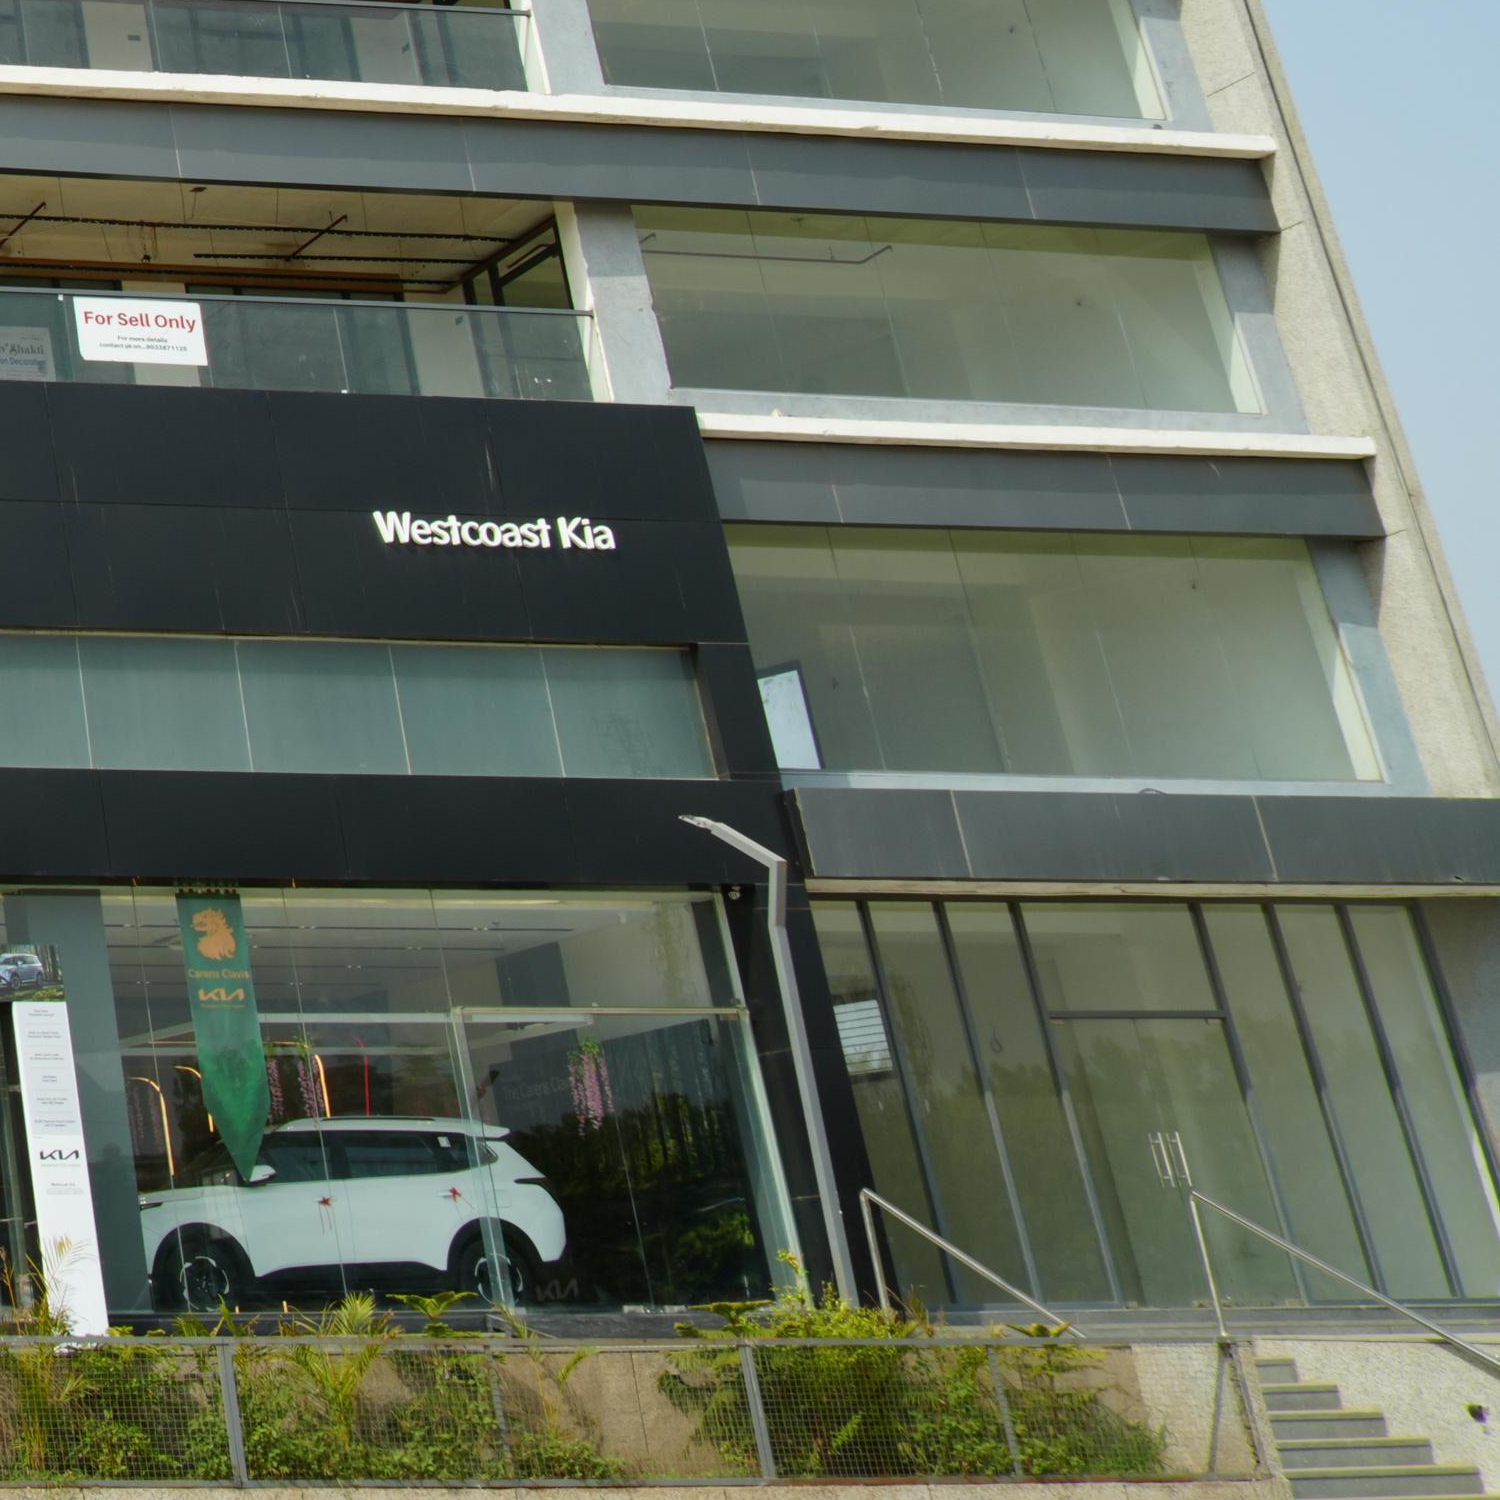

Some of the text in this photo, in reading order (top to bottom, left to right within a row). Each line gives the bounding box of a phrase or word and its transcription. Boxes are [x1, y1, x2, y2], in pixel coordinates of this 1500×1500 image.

[83, 311, 196, 333] For Sell Only
[371, 510, 616, 550] Westcoast Kia
[198, 987, 246, 1001] KIA
[38, 1149, 80, 1161] KIA
